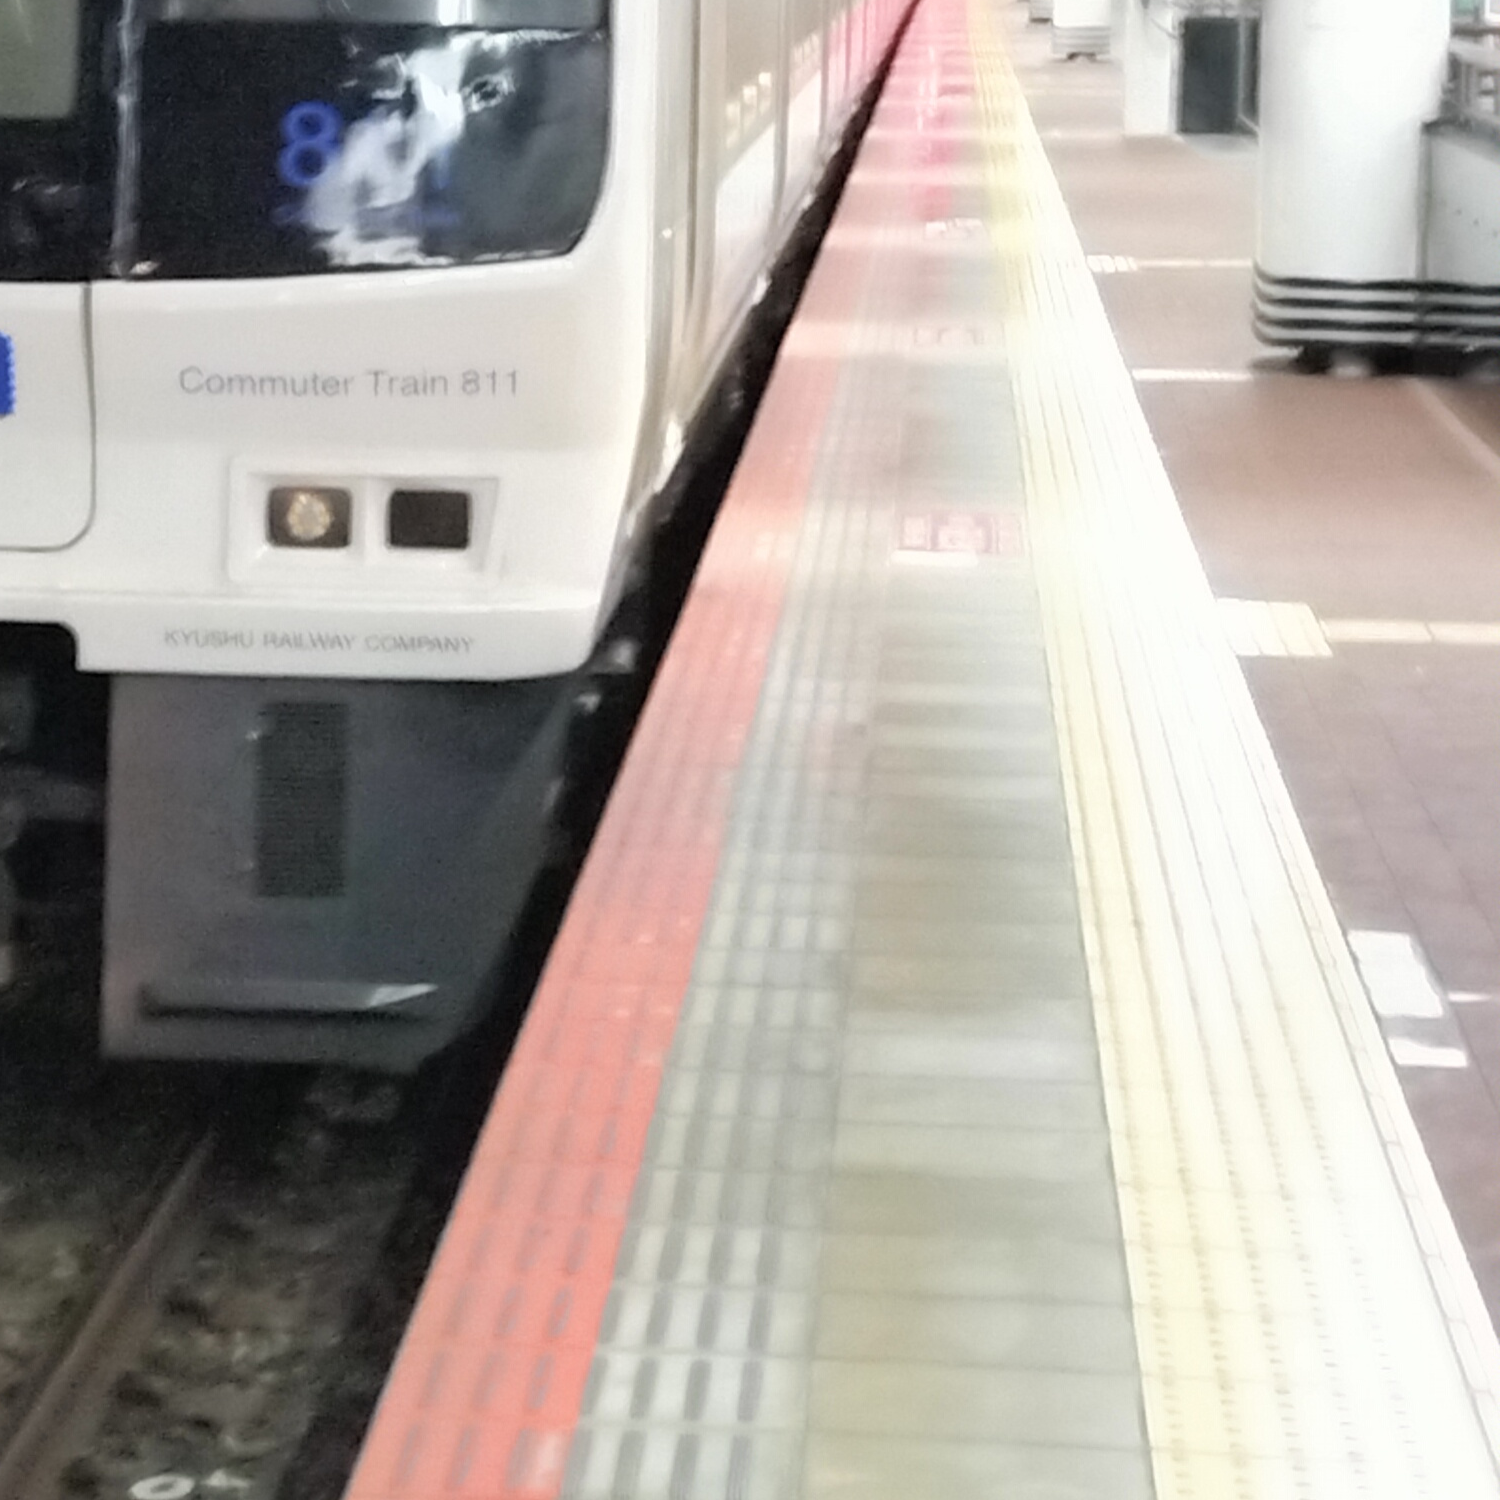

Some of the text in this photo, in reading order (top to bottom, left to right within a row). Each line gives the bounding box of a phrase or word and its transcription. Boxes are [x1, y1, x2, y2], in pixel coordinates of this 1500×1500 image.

[178, 365, 519, 397] Commuter Train 811
[163, 629, 475, 653] KYUSHU RAILWAY COMPANY
